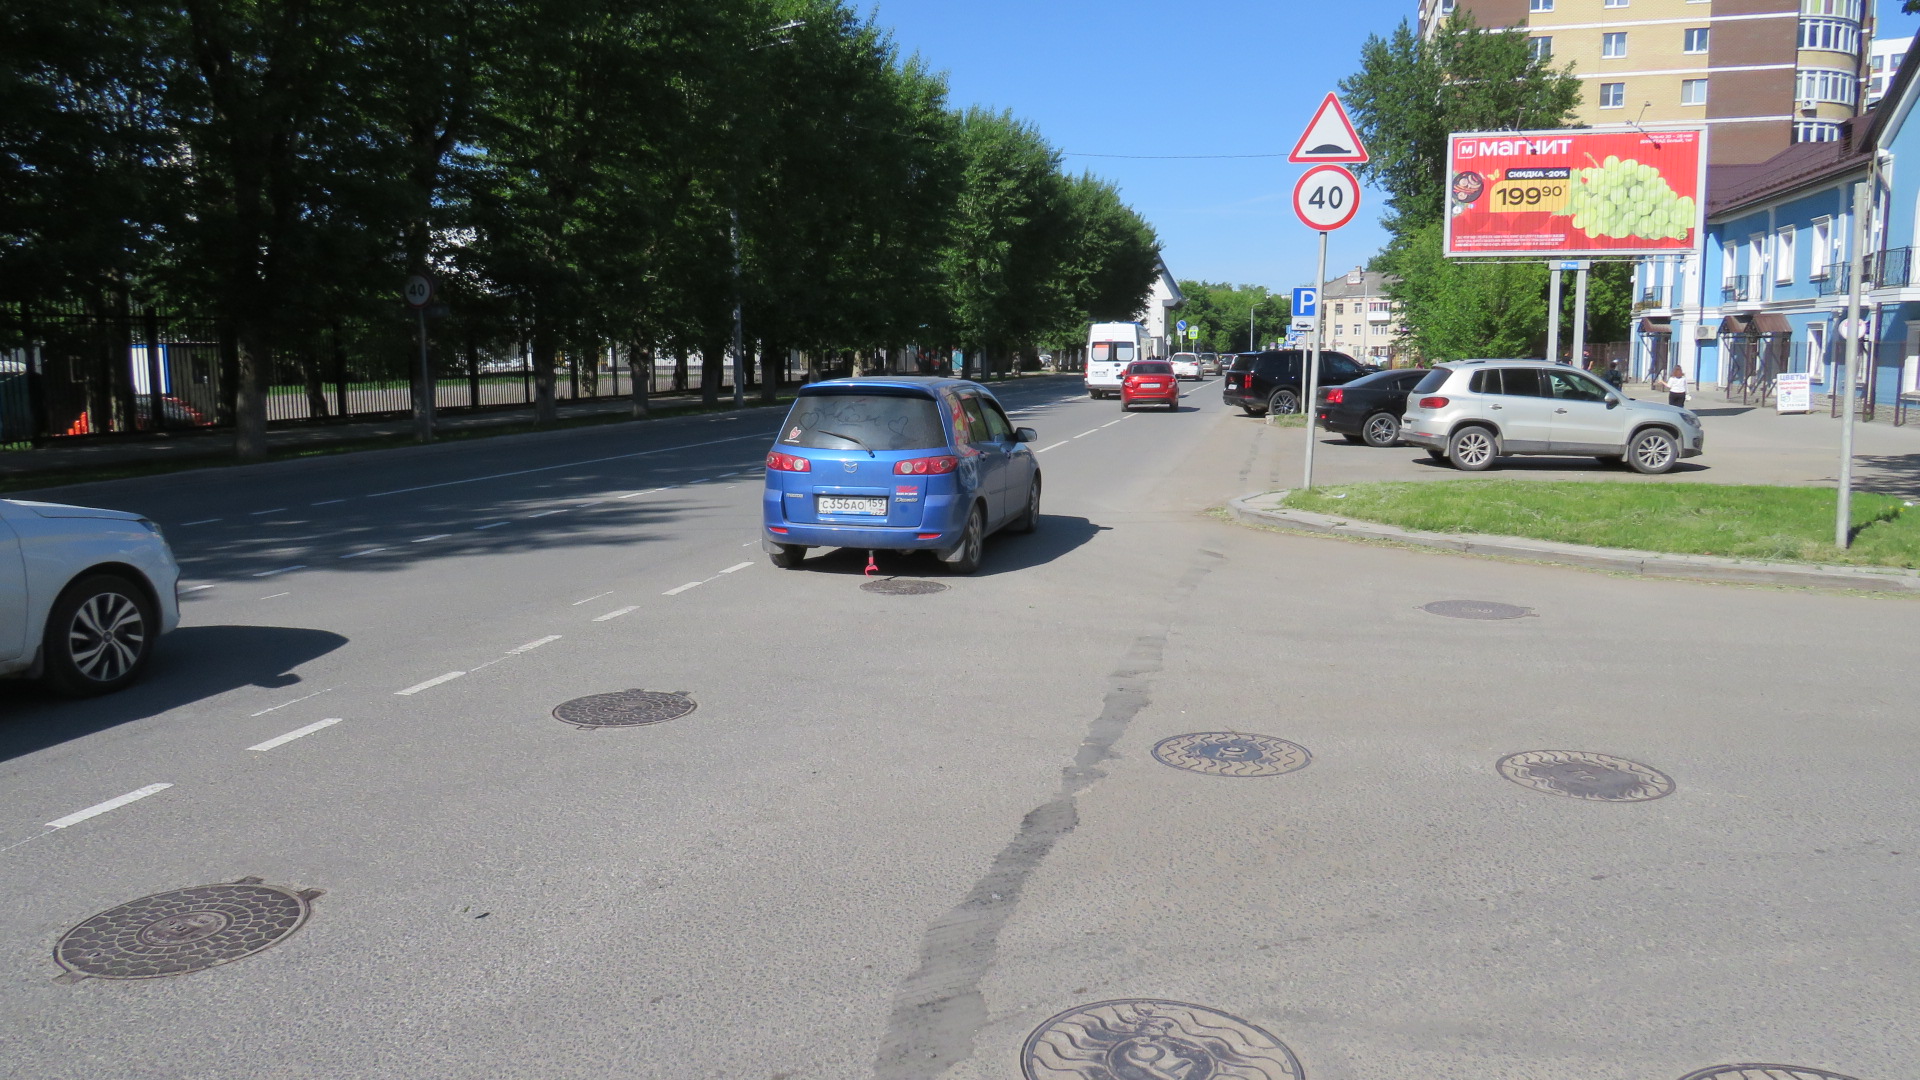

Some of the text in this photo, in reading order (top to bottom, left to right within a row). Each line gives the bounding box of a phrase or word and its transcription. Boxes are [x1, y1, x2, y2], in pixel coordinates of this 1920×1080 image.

[1508, 170, 1544, 178] СКИДКА
[1308, 185, 1344, 210] 40
[1496, 186, 1542, 206] 199
[409, 283, 425, 297] 40
[1300, 290, 1316, 314] P
[867, 498, 884, 508] 159
